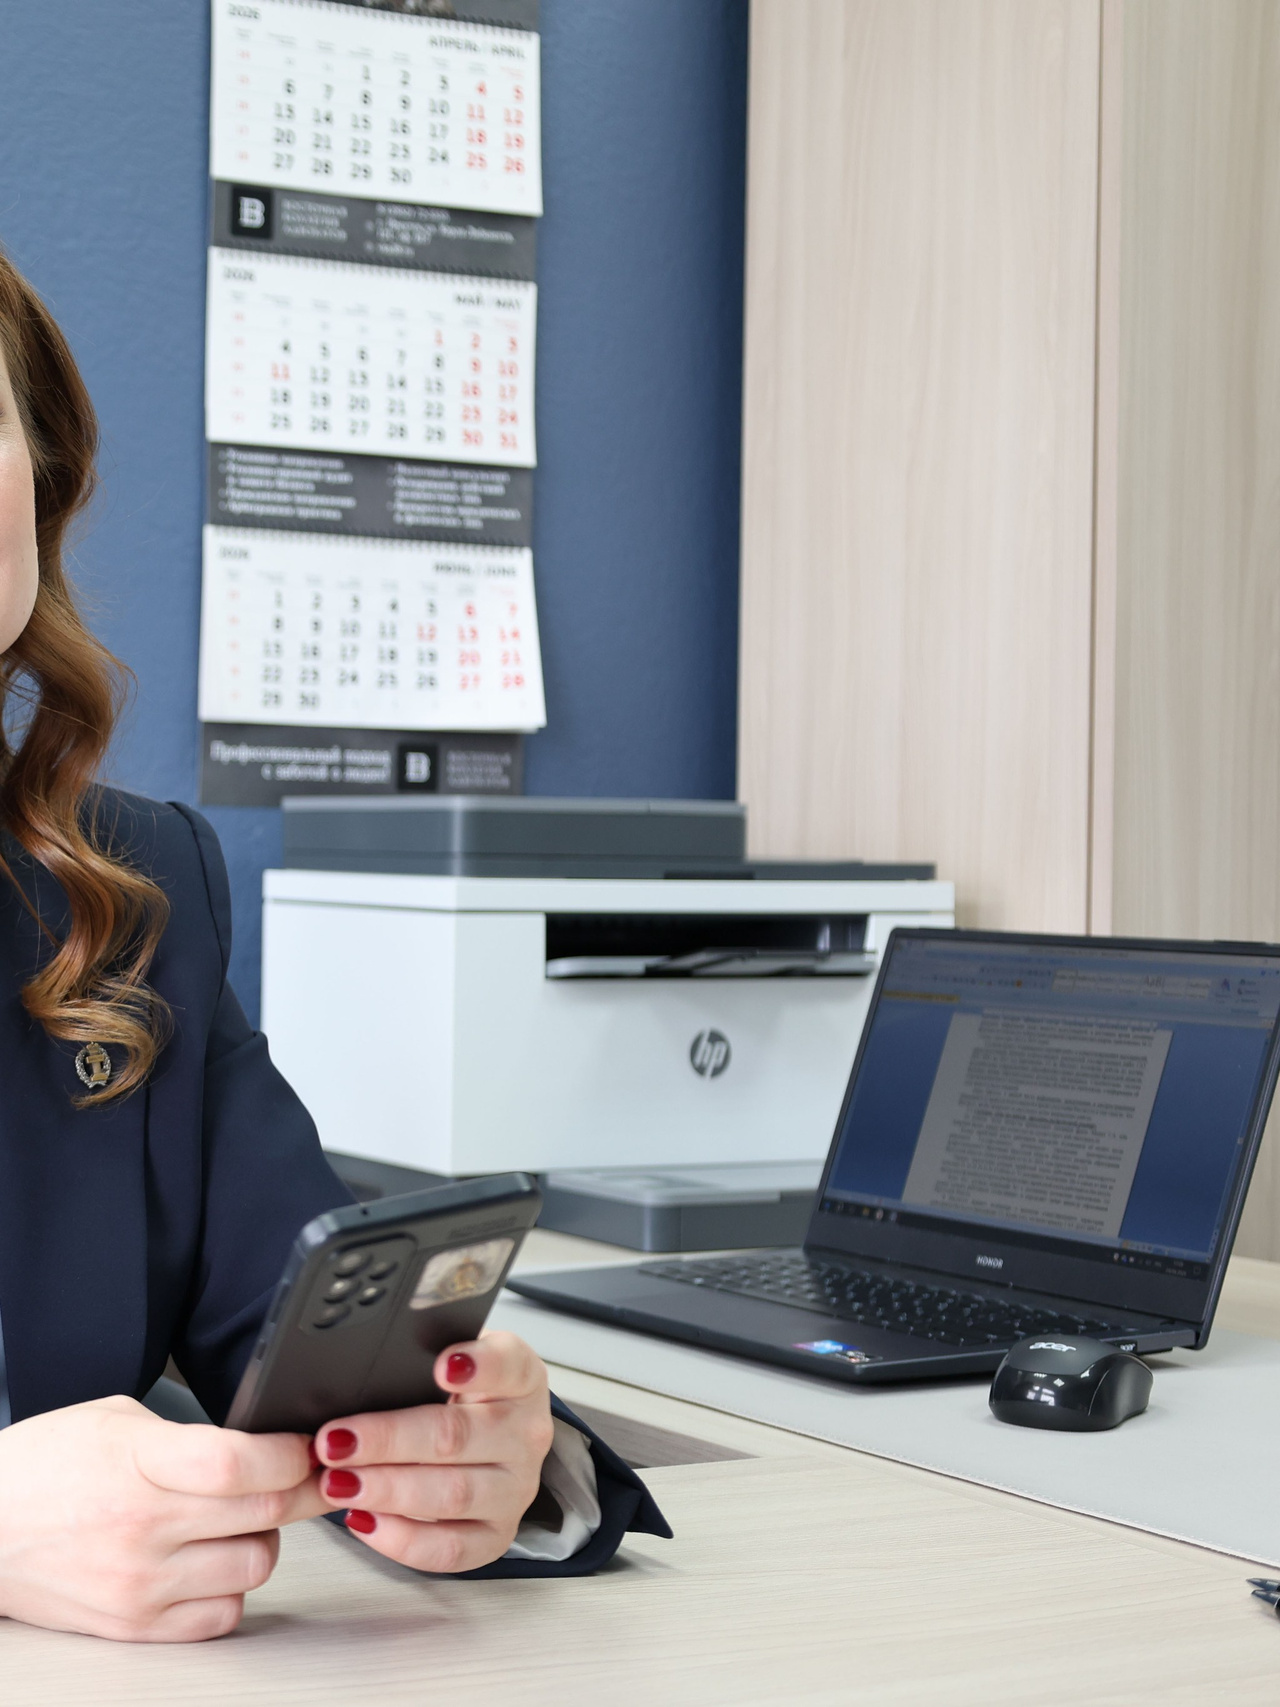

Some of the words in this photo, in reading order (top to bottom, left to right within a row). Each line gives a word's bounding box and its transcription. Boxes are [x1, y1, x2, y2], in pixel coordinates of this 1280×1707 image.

[229, 6, 261, 20] 2026
[275, 103, 295, 121] 13
[313, 108, 333, 126] 14
[351, 113, 371, 131] 15
[391, 118, 410, 136] 16
[429, 123, 448, 141] 17
[468, 128, 486, 145] 18
[505, 133, 524, 150] 19
[429, 99, 450, 117] 10
[467, 104, 485, 121] 11
[504, 109, 523, 126] 12
[274, 127, 296, 145] 20
[312, 133, 332, 152] 21
[350, 138, 371, 157] 22
[389, 143, 410, 160] 23
[428, 146, 449, 164] 24
[466, 152, 486, 168] 25
[504, 156, 524, 174] 26
[273, 152, 295, 170] 27
[312, 158, 332, 175] 28
[350, 163, 372, 180] 29
[391, 167, 411, 184] 30
[690, 1027, 732, 1080] hp
[976, 1255, 1003, 1269] HONOR
[1029, 1342, 1076, 1352] acer
